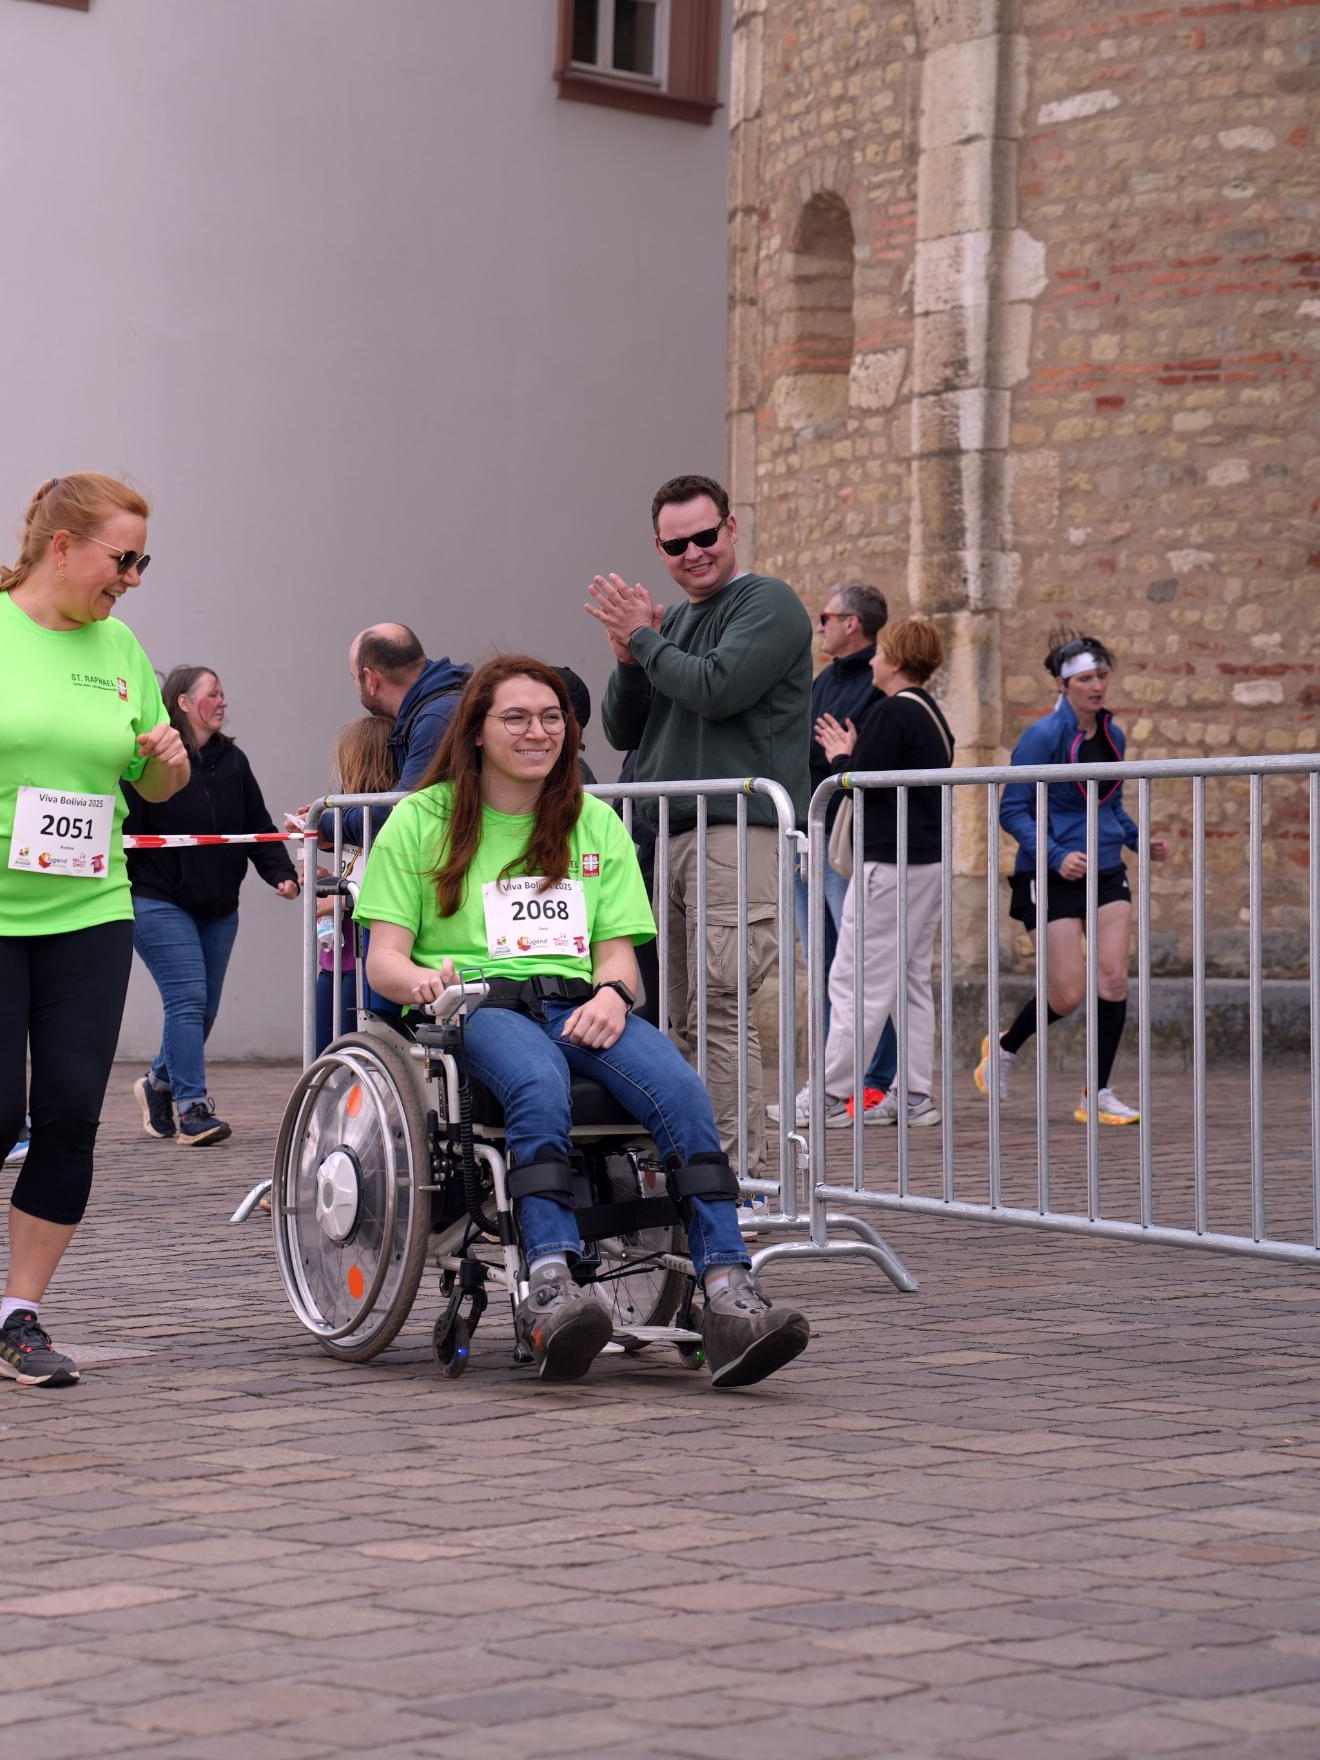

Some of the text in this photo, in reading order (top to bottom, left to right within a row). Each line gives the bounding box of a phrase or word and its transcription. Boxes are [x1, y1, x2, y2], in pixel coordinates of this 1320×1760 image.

[71, 673, 83, 682] ST.
[84, 675, 116, 687] RAPHAEL
[39, 793, 104, 808] Viva Bolivia 2025
[40, 814, 93, 840] 2051
[503, 881, 522, 891] Viva
[555, 882, 572, 891] 2025
[511, 900, 569, 921] 2068
